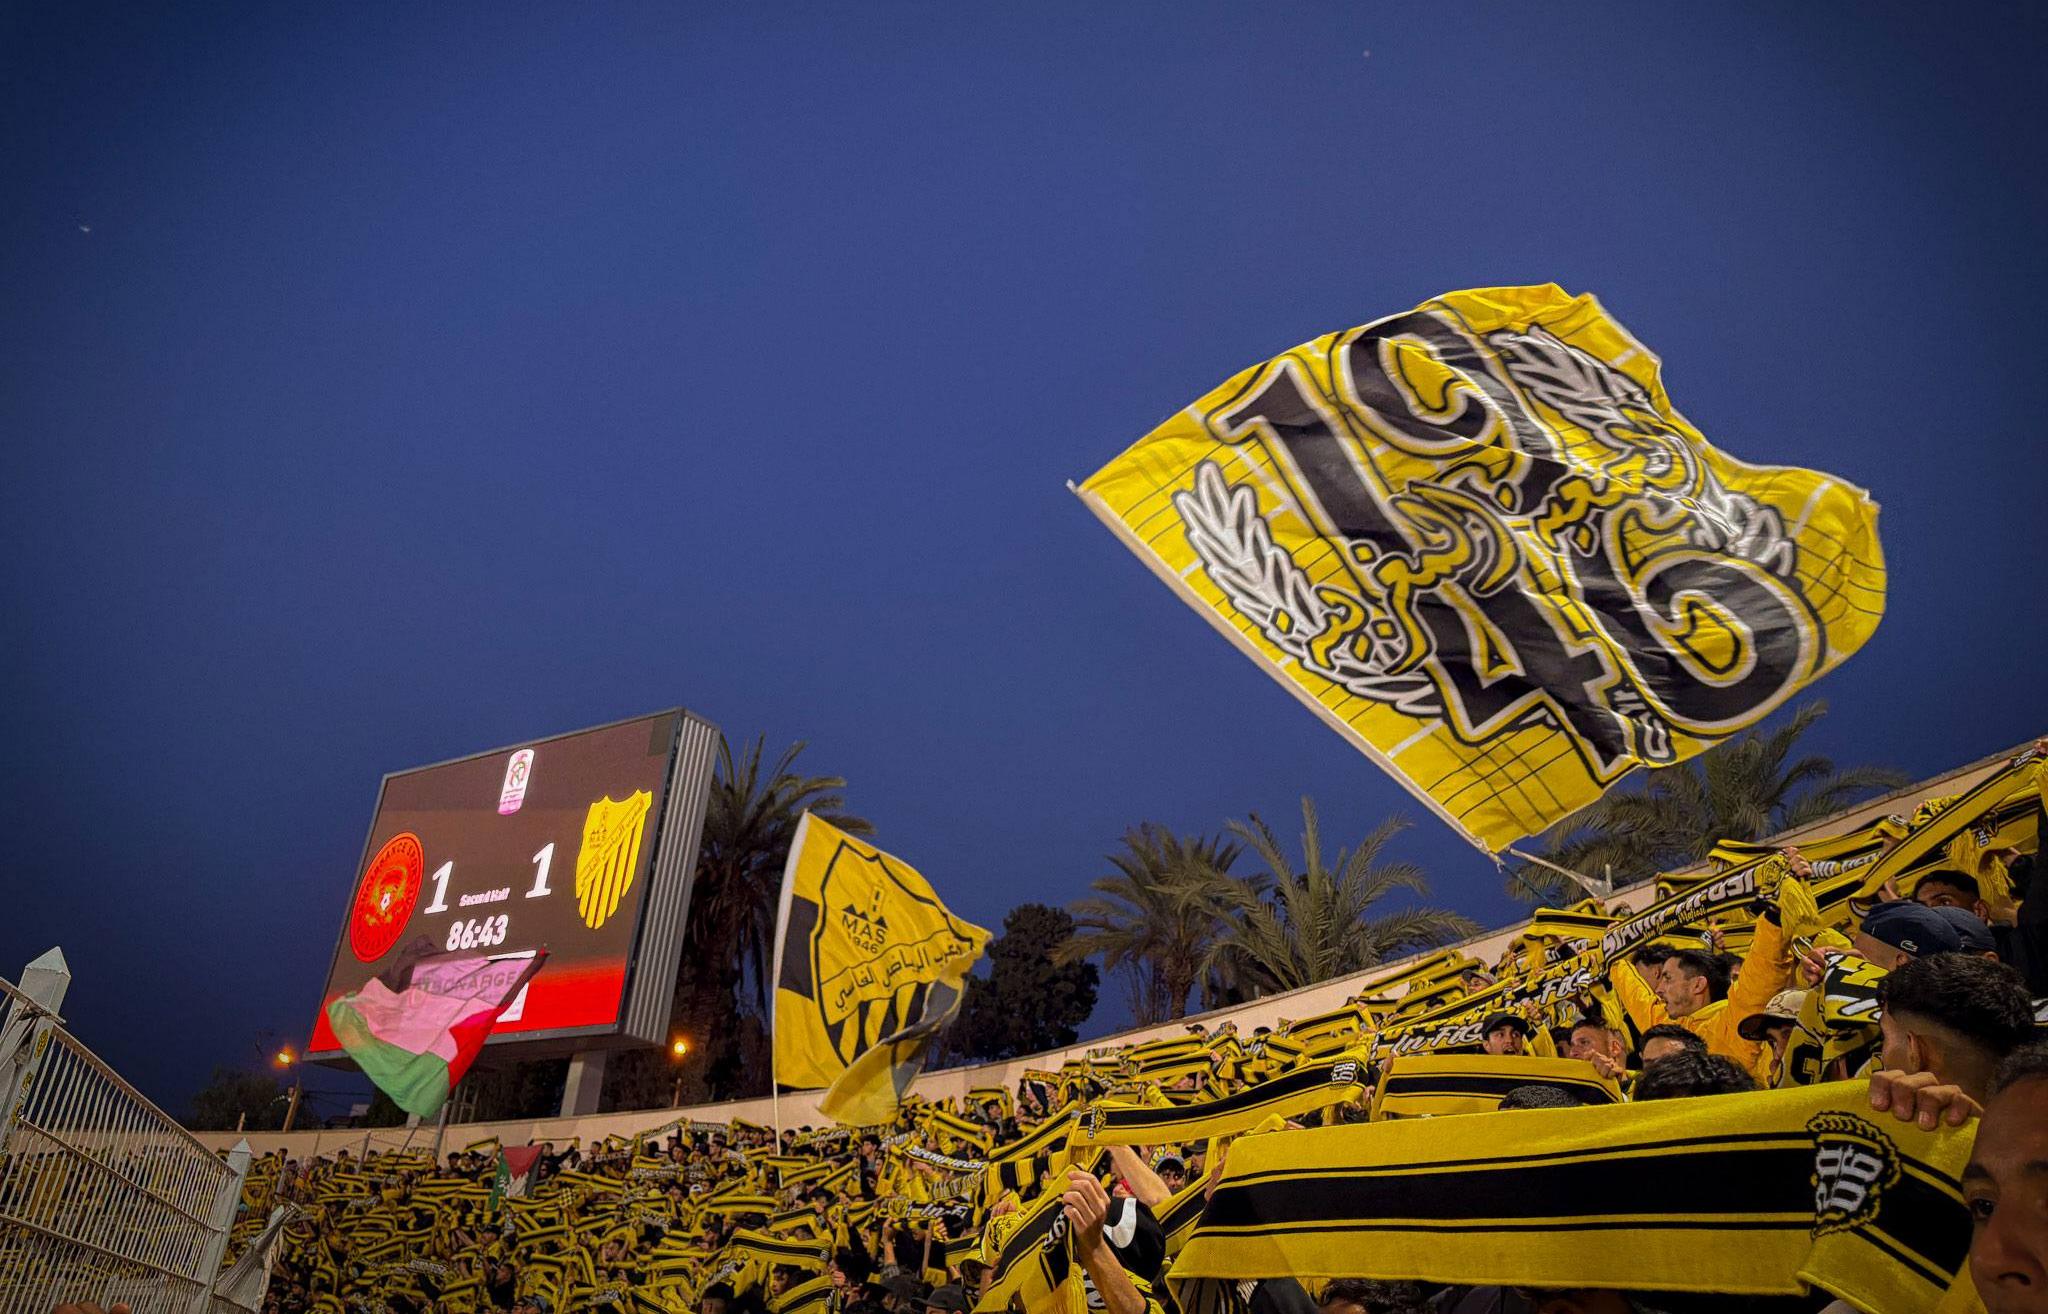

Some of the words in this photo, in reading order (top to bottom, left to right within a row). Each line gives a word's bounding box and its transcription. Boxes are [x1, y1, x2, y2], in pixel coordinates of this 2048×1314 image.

[424, 861, 453, 914] 1
[525, 843, 554, 898] 1
[446, 914, 509, 952] 86:43
[842, 914, 887, 945] MAS
